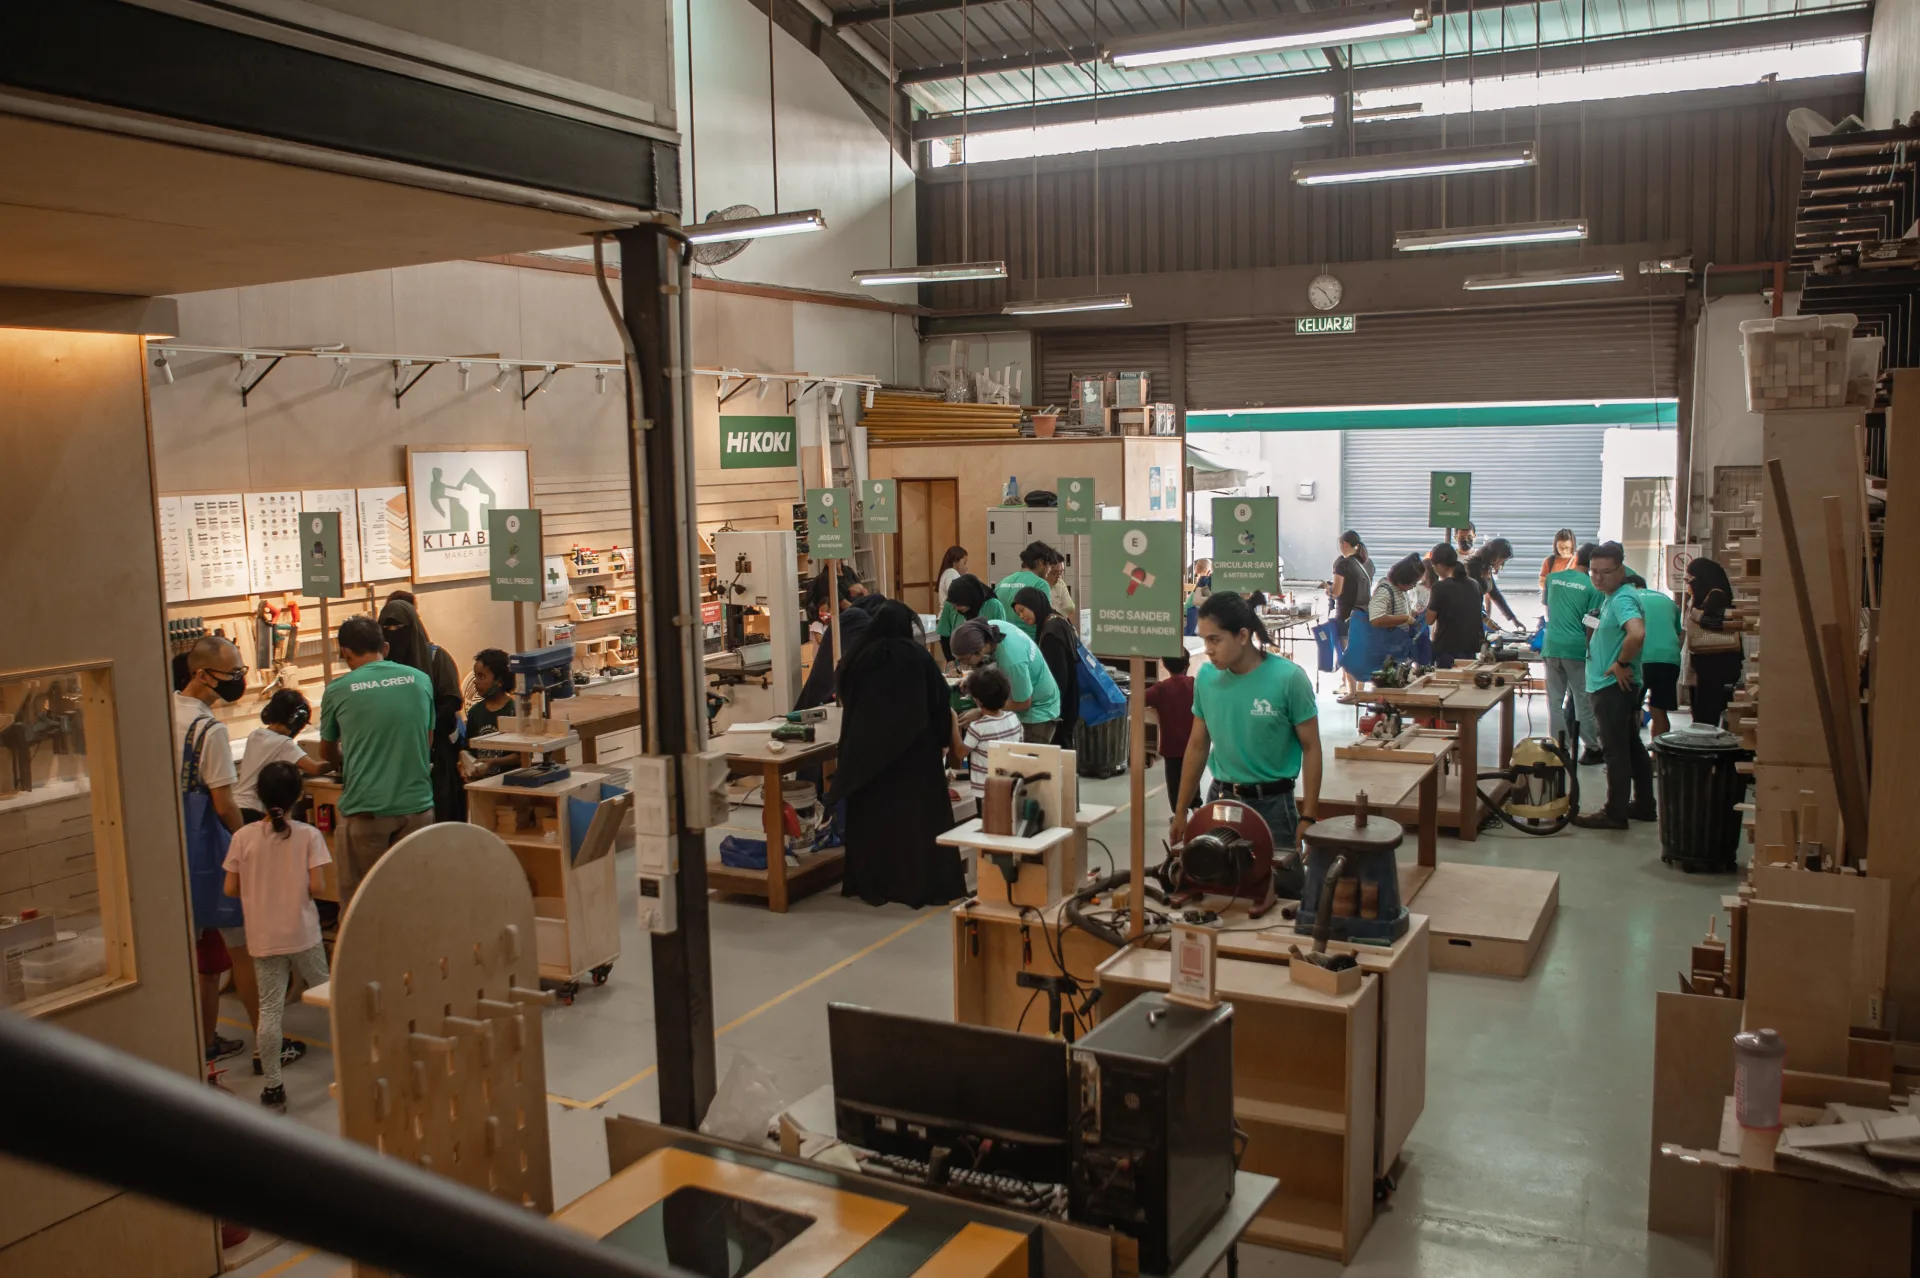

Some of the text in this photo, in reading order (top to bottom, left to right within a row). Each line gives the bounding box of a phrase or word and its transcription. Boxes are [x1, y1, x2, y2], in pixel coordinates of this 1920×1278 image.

[1298, 317, 1342, 332] KELUAR
[187, 528, 196, 562] FASTENERS
[423, 531, 486, 549] KITAB
[1131, 537, 1138, 547] E
[444, 548, 474, 559] MAKER
[1566, 582, 1586, 591] CREW
[1099, 609, 1170, 621] DISC SANDER
[1096, 625, 1176, 636] & SPINDLE SANDER
[350, 674, 415, 692] BINA CREW
